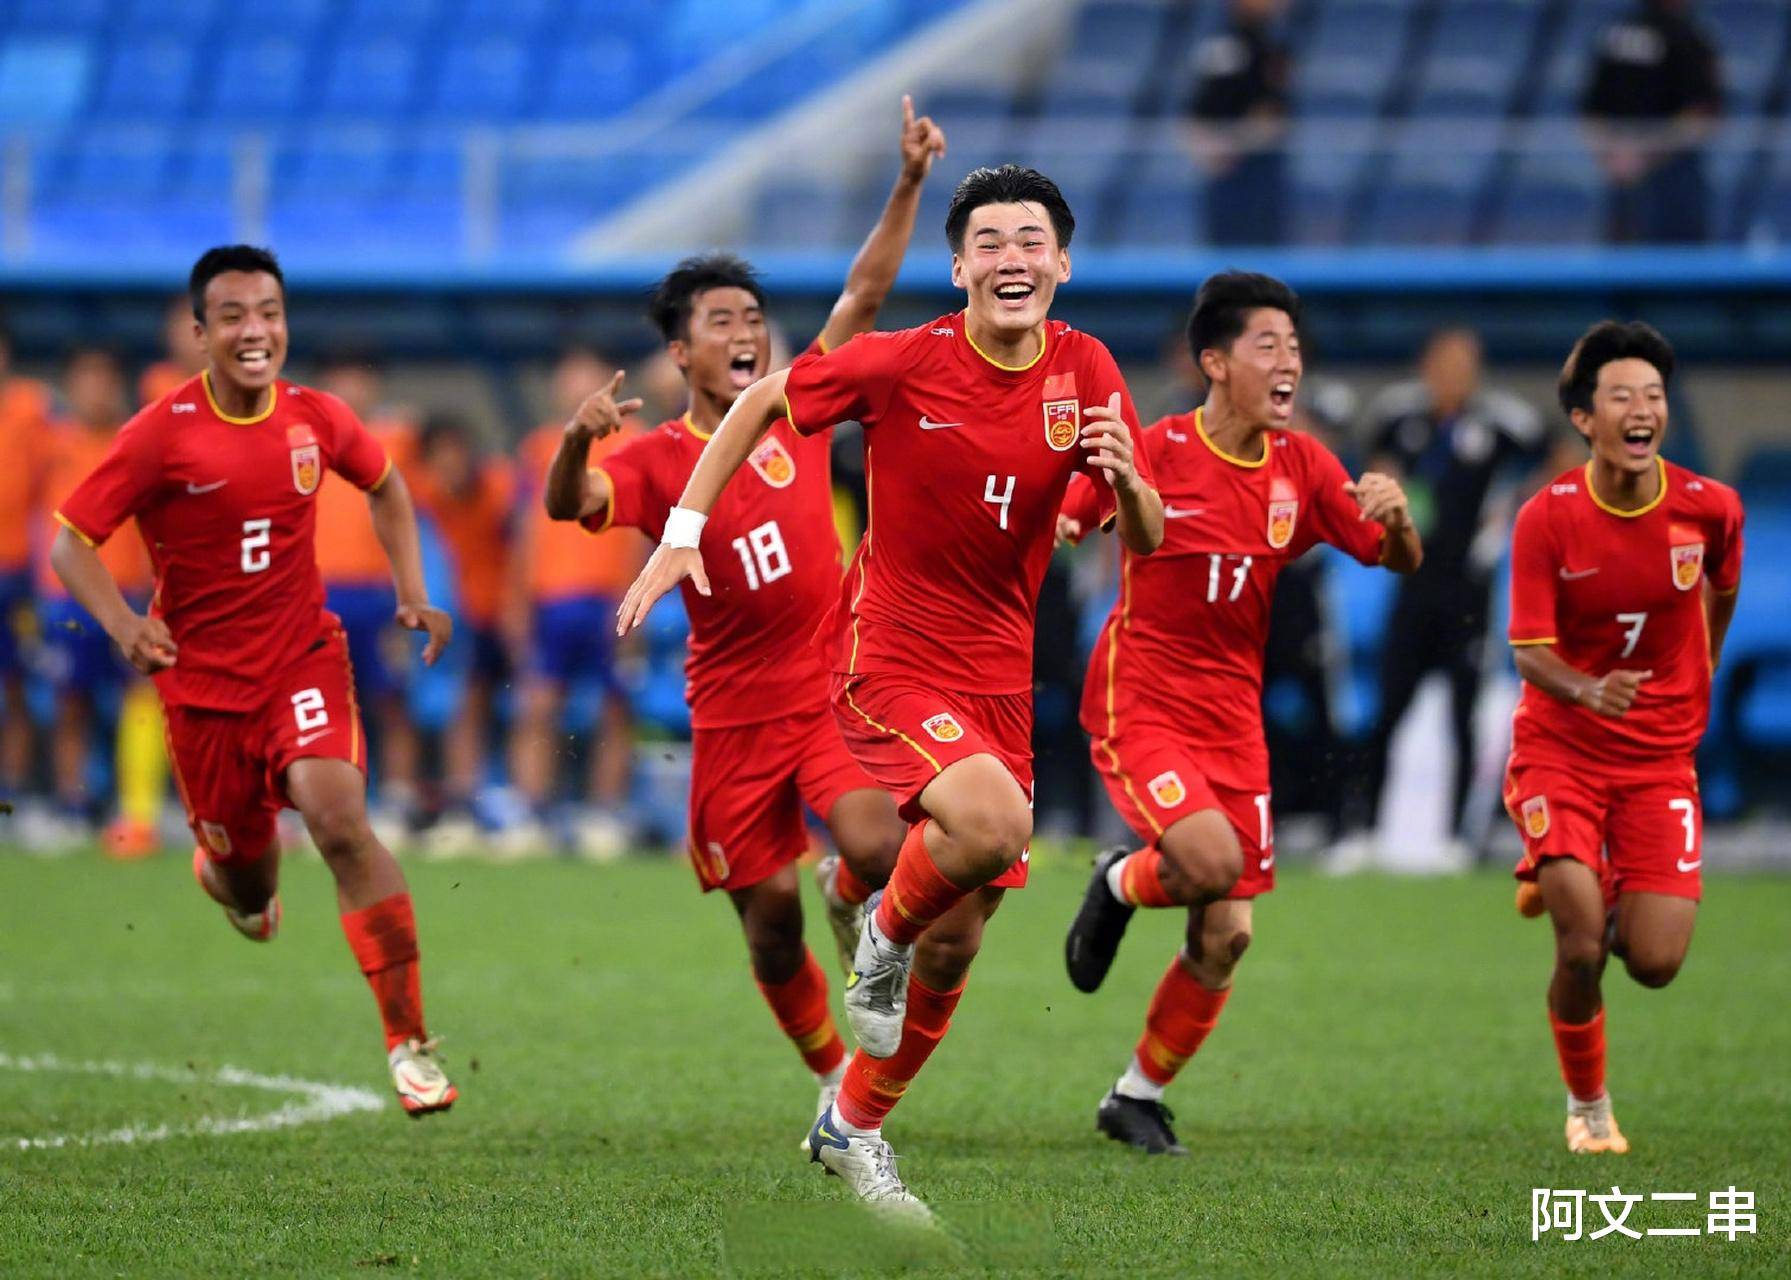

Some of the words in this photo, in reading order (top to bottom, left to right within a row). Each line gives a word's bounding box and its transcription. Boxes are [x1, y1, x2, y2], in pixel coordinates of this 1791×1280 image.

[984, 474, 1017, 530] 4
[241, 518, 272, 574] 2
[731, 520, 793, 591] 18
[1616, 612, 1648, 658] 7
[290, 687, 329, 732] 2
[1669, 798, 1695, 853] 7
